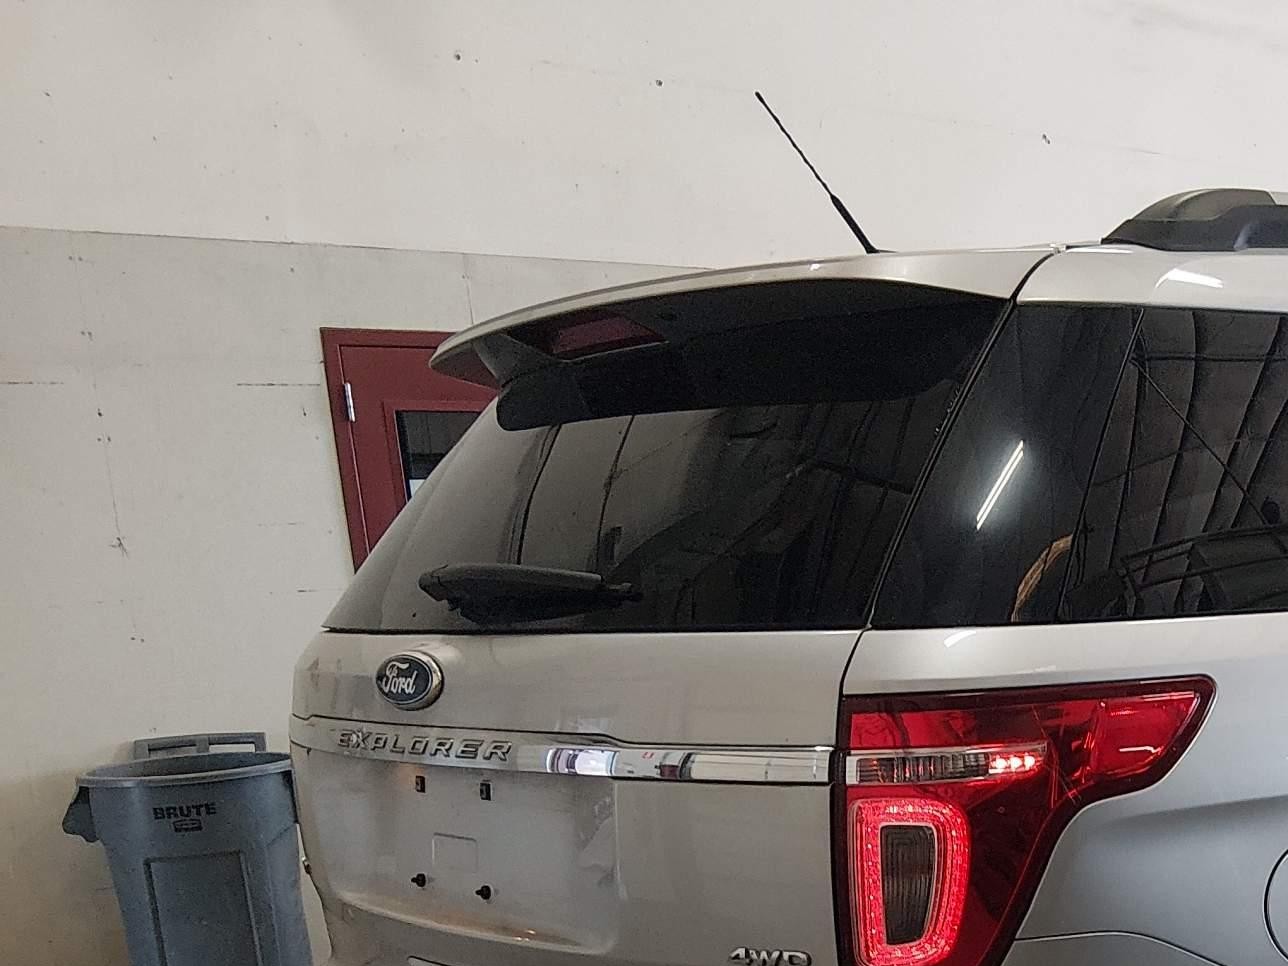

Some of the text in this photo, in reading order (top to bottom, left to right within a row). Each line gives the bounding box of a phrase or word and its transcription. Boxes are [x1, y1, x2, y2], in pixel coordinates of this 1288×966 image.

[382, 660, 418, 695] Ford
[337, 728, 513, 762] EXPLORER
[152, 802, 217, 820] BRUTE
